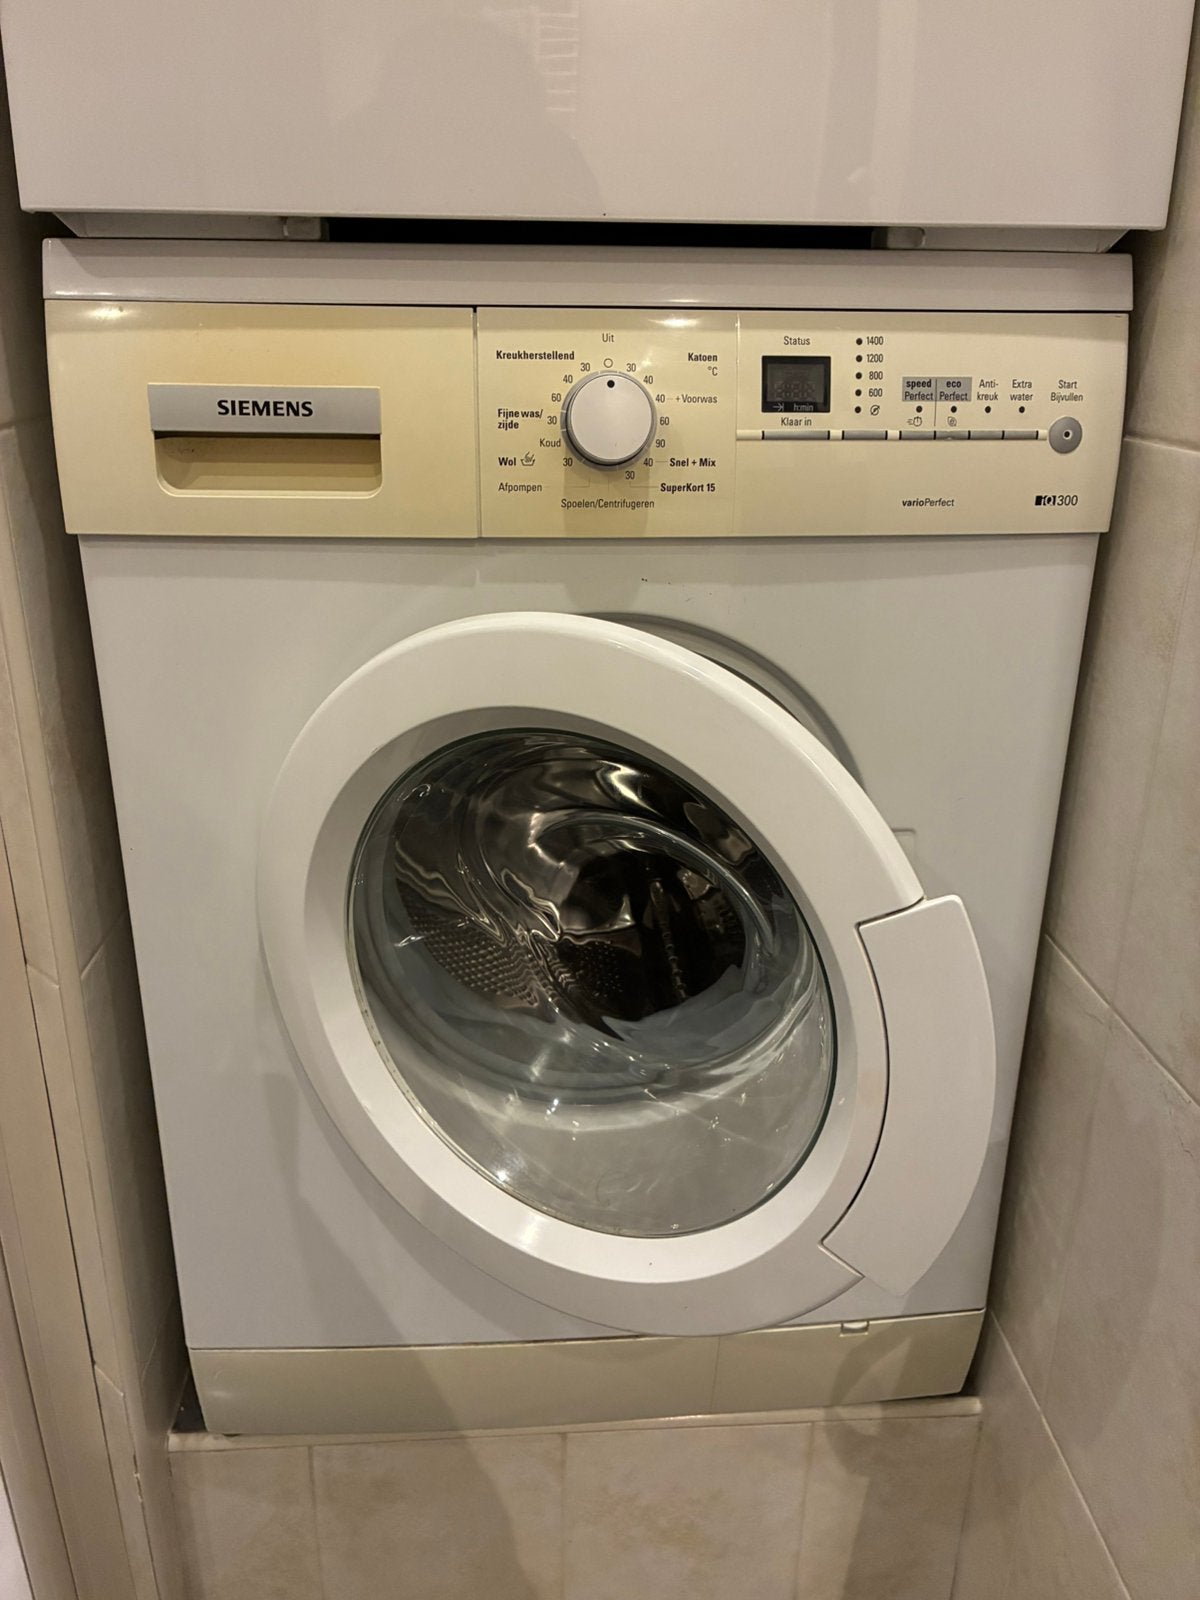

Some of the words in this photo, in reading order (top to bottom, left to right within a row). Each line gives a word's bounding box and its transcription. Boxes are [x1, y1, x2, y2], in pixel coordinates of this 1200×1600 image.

[602, 333, 614, 342] Uit
[784, 336, 810, 346] Status
[866, 336, 883, 345] 1400
[496, 350, 575, 360] Kreukherstellend
[688, 353, 718, 362] Katoen
[867, 354, 883, 363] 1200
[581, 363, 590, 372] 30
[626, 363, 636, 372] 30
[563, 375, 573, 383] 40
[644, 375, 653, 384] 40
[869, 371, 883, 380] 800
[906, 379, 932, 389] speed
[979, 380, 999, 389] Anti-
[1012, 379, 1032, 389] Extra
[1058, 380, 1077, 389] Start
[869, 388, 883, 397] 600
[904, 392, 933, 401] Perfect
[939, 392, 968, 401] Perfect
[977, 392, 998, 401] kreuk
[1010, 393, 1033, 401] water
[551, 394, 561, 402] 60
[656, 394, 665, 403] 40
[682, 394, 718, 403] Voorwas
[1050, 392, 1084, 403] Bijvullen
[217, 400, 313, 417] SIEMENS
[497, 409, 520, 419] Fijne
[521, 408, 543, 419] was/
[497, 420, 519, 430] zijde
[547, 416, 557, 425] 30
[660, 417, 670, 425] 60
[781, 417, 802, 426] Klaar
[804, 417, 812, 426] in
[539, 439, 561, 448] Koud
[656, 439, 665, 448] 90
[498, 457, 516, 466] Wol
[563, 458, 573, 467] 30
[644, 458, 653, 467] 40
[670, 458, 689, 467] Snel
[699, 458, 716, 467] Mix
[625, 471, 635, 480] 30
[498, 483, 542, 493] Afpompen
[660, 483, 705, 493] SuperKort
[706, 483, 716, 492] 15
[561, 499, 654, 510] Spoelen/Centrifugeren
[902, 498, 954, 507] varioPerfect
